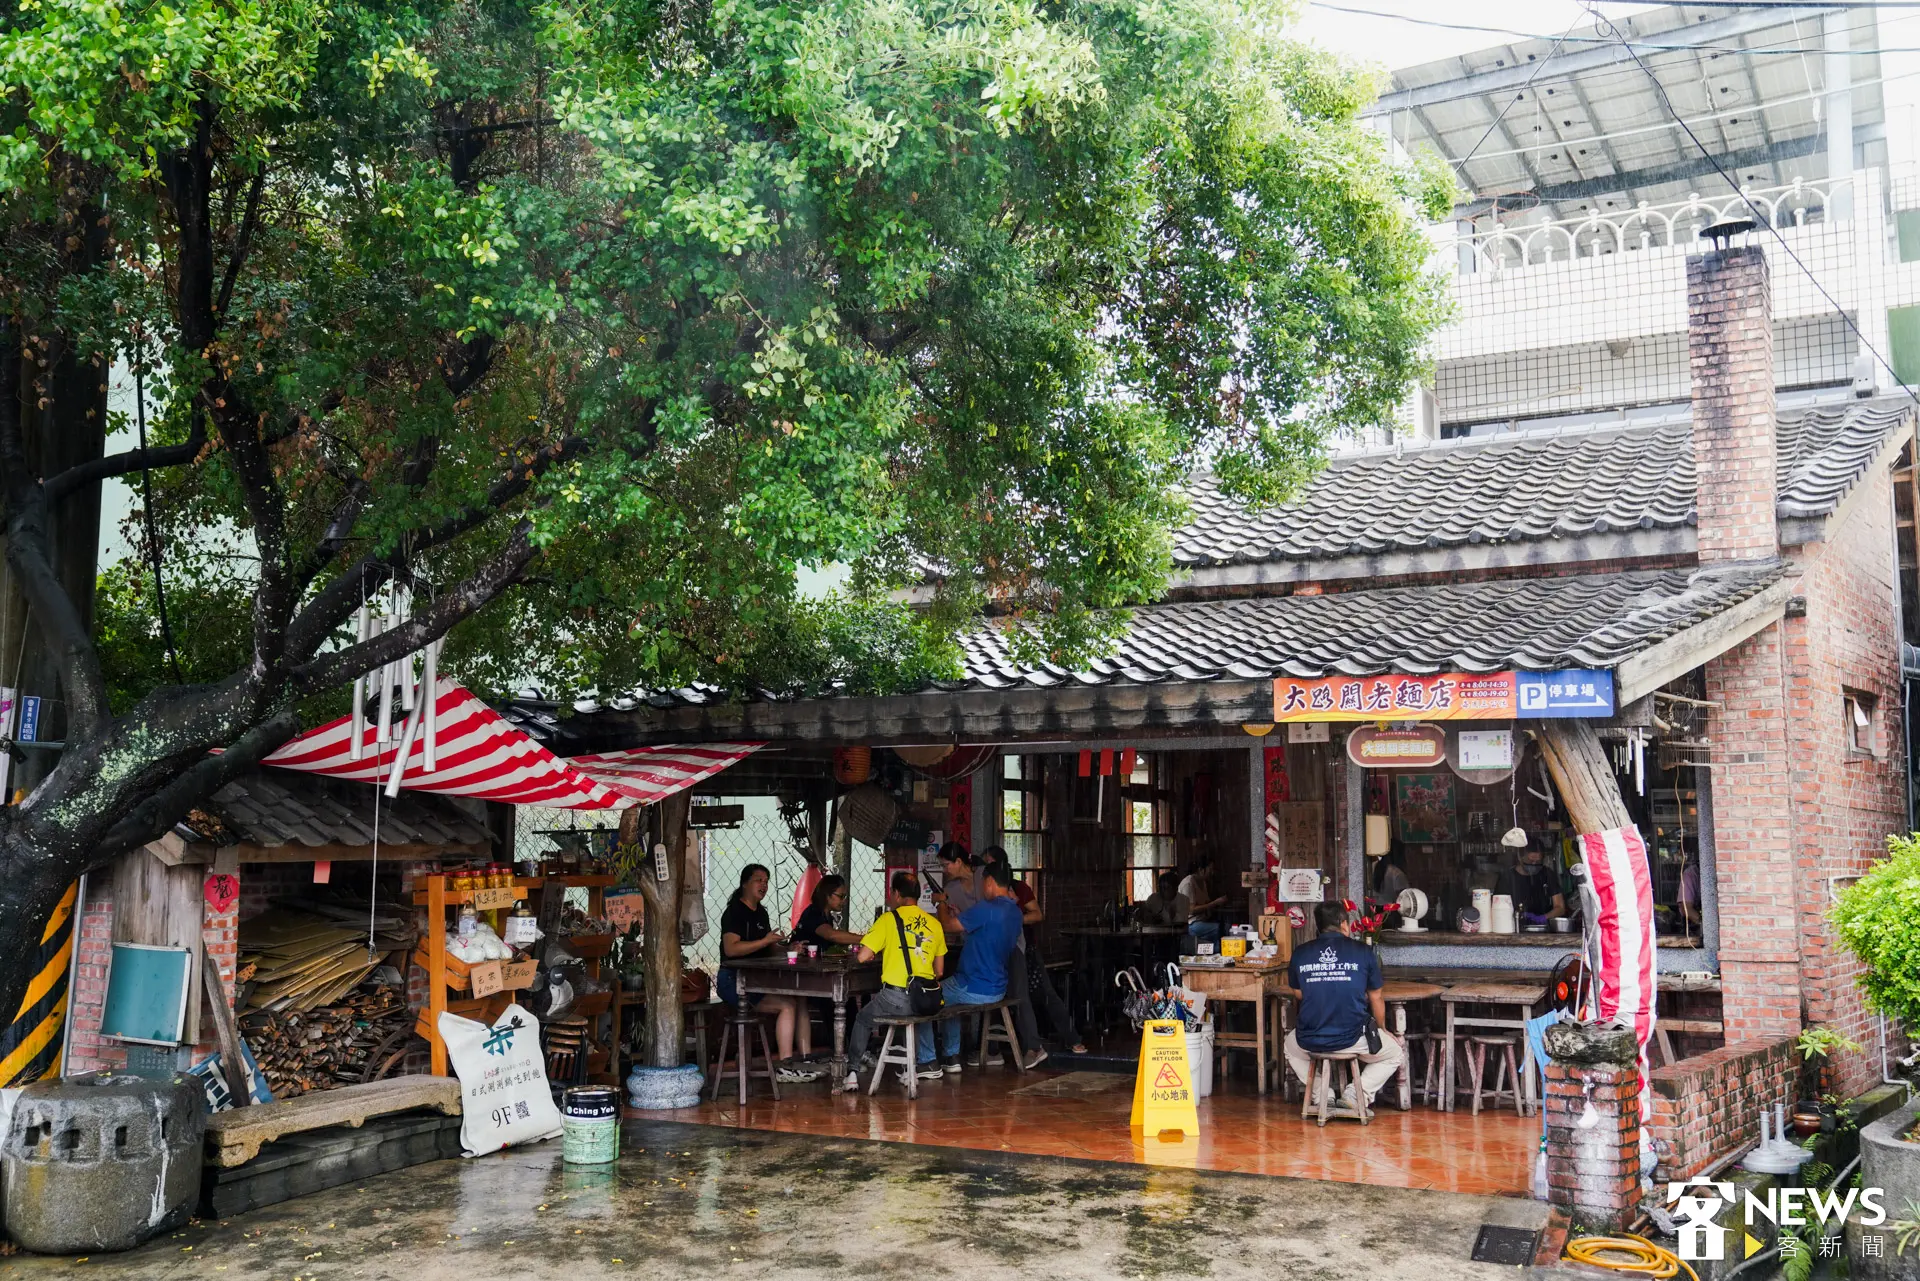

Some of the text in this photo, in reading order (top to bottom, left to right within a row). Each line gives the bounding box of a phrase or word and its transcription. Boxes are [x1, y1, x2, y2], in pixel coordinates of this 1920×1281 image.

[1283, 680, 1455, 711] 大路關老麵店
[1472, 690, 1508, 698] 8:00-19:00
[1526, 687, 1541, 705] P
[1549, 684, 1595, 698] 停車場
[1151, 1089, 1189, 1101] 小心地滑
[492, 1105, 512, 1129] 9F
[573, 1105, 615, 1116] Ching Yeh
